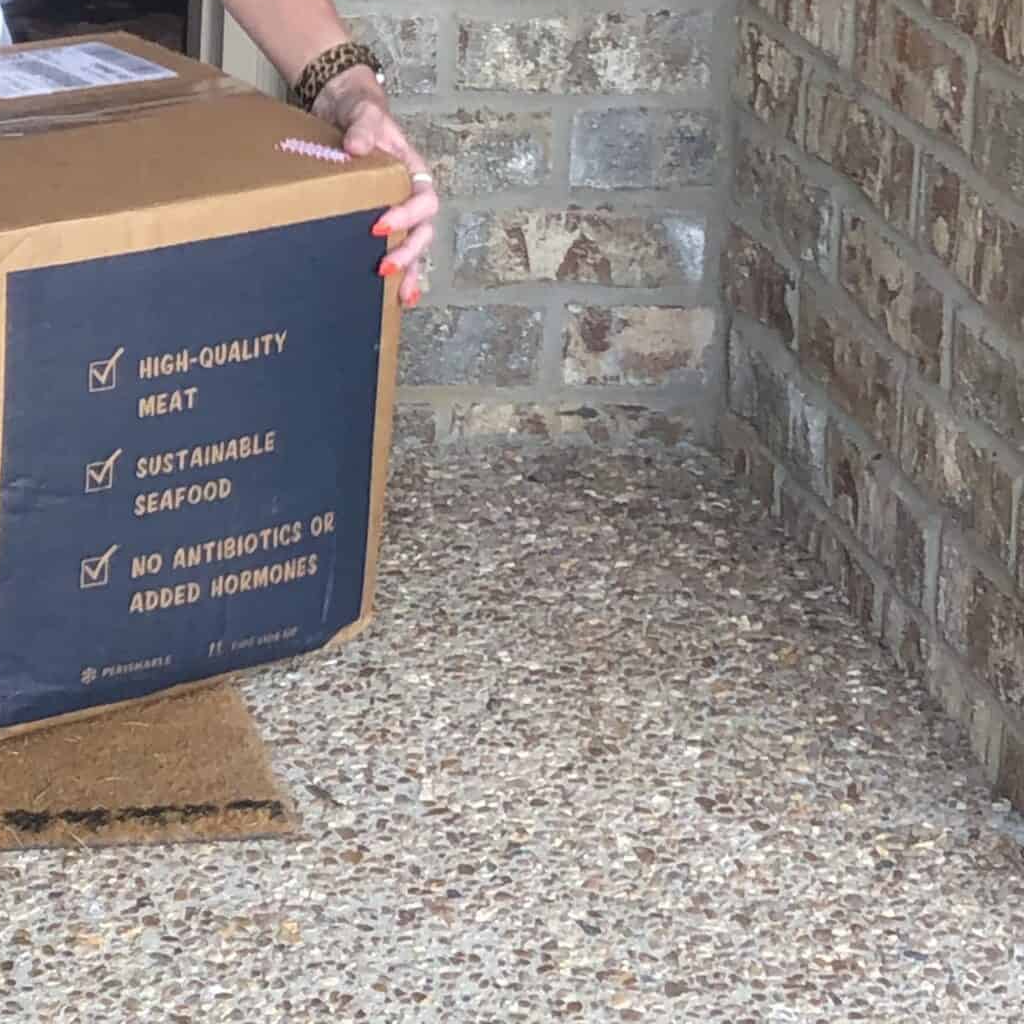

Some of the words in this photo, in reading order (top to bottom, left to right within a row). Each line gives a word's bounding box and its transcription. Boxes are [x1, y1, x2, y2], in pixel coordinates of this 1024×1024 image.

[139, 330, 287, 379] HIGH-QUALITY
[138, 387, 198, 418] MEAT
[136, 430, 276, 479] SUSTAINABLE
[134, 478, 232, 516] SEAFOOD
[131, 553, 163, 579] NO
[173, 521, 302, 570] ANTIBIOTICS
[310, 511, 336, 536] OR
[129, 582, 201, 614] ADDED
[211, 553, 318, 599] HORMONES
